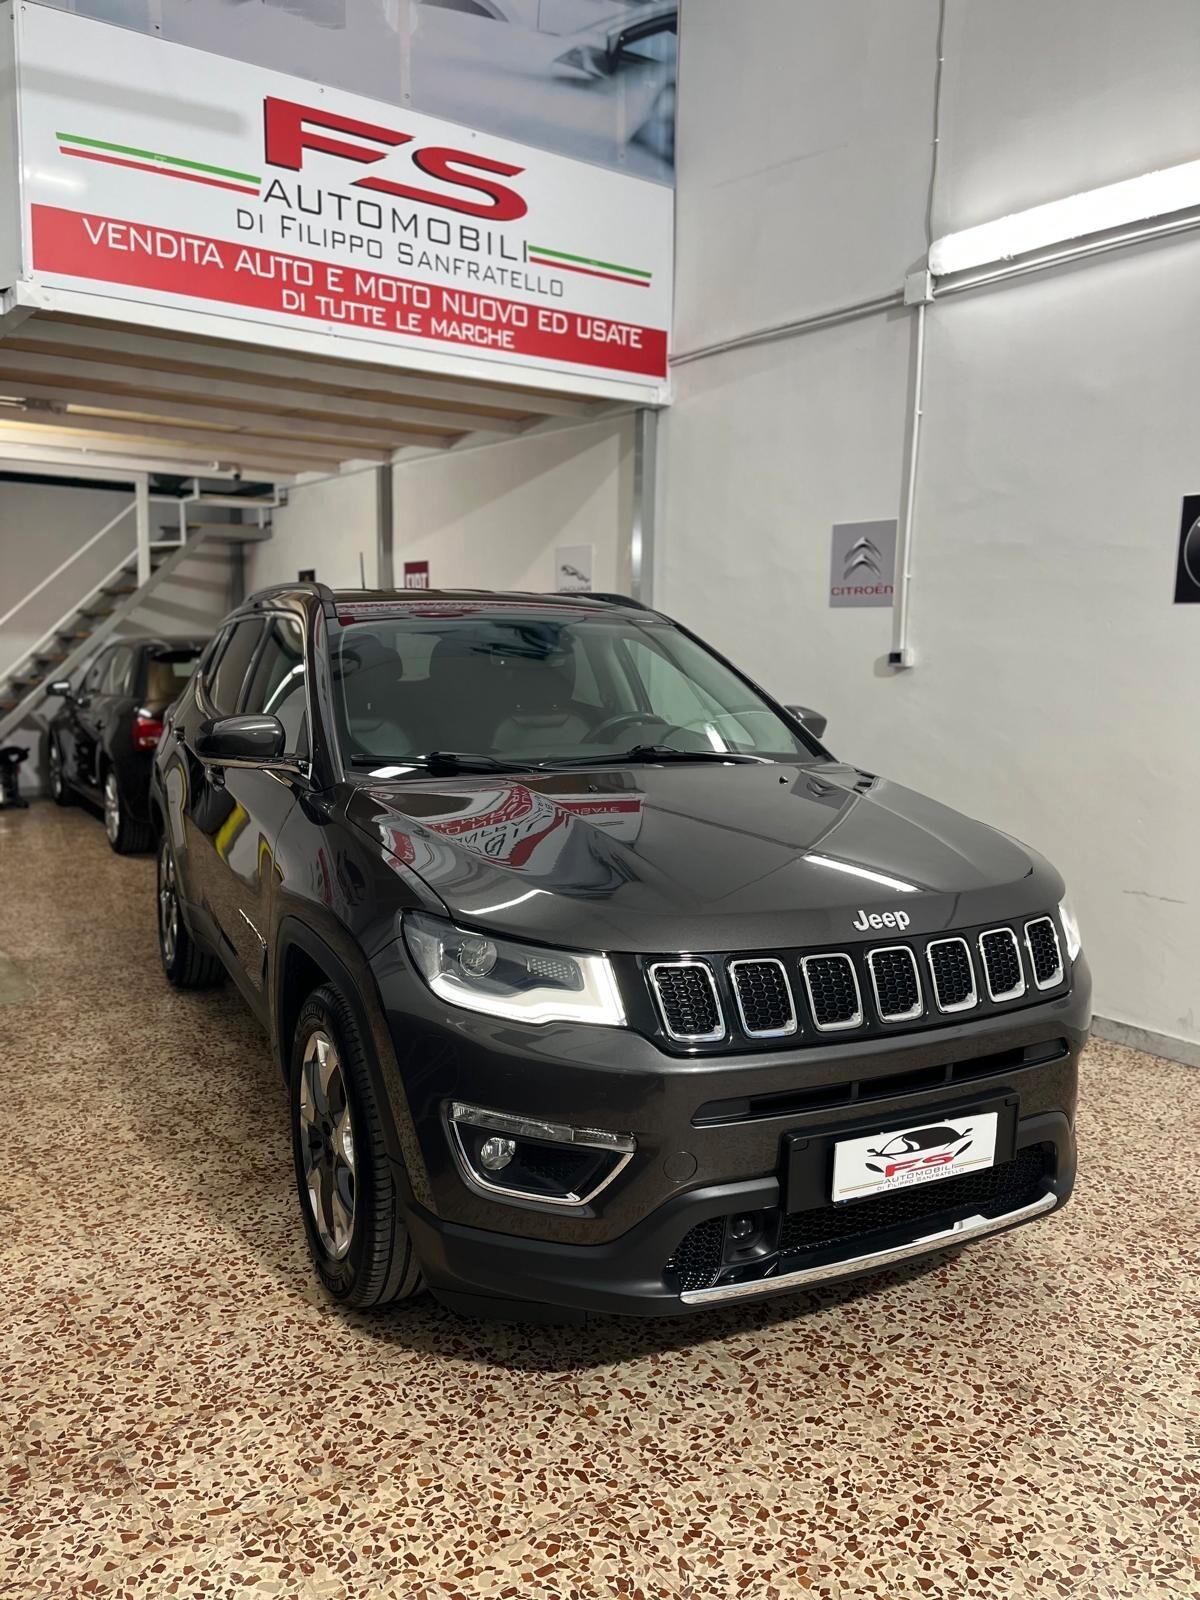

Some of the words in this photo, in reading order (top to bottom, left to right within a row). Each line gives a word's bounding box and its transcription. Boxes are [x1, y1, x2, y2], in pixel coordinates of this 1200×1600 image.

[263, 95, 528, 221] FS
[264, 179, 527, 263] AUTOMOBILI
[237, 208, 263, 233] DI
[281, 215, 383, 259] FILIPPO
[398, 242, 564, 297] SANFRATELLO
[83, 217, 224, 269] VENDITA
[235, 249, 313, 286] AUTO
[327, 267, 344, 293] E
[355, 273, 430, 309] MOTO
[442, 290, 528, 327] NUOVO
[538, 311, 568, 335] ED
[577, 317, 643, 349] USATE
[282, 289, 305, 312] DI
[315, 295, 386, 327] TUTTE
[396, 310, 422, 333] LE
[431, 317, 515, 349] MARCHE
[853, 910, 910, 930] Jeep
[884, 1164, 954, 1184] AUTOMOBILI
[885, 1152, 954, 1177] FS
[887, 1180, 914, 1188] FILIPPO
[917, 1168, 965, 1180] SANFRATELLO
